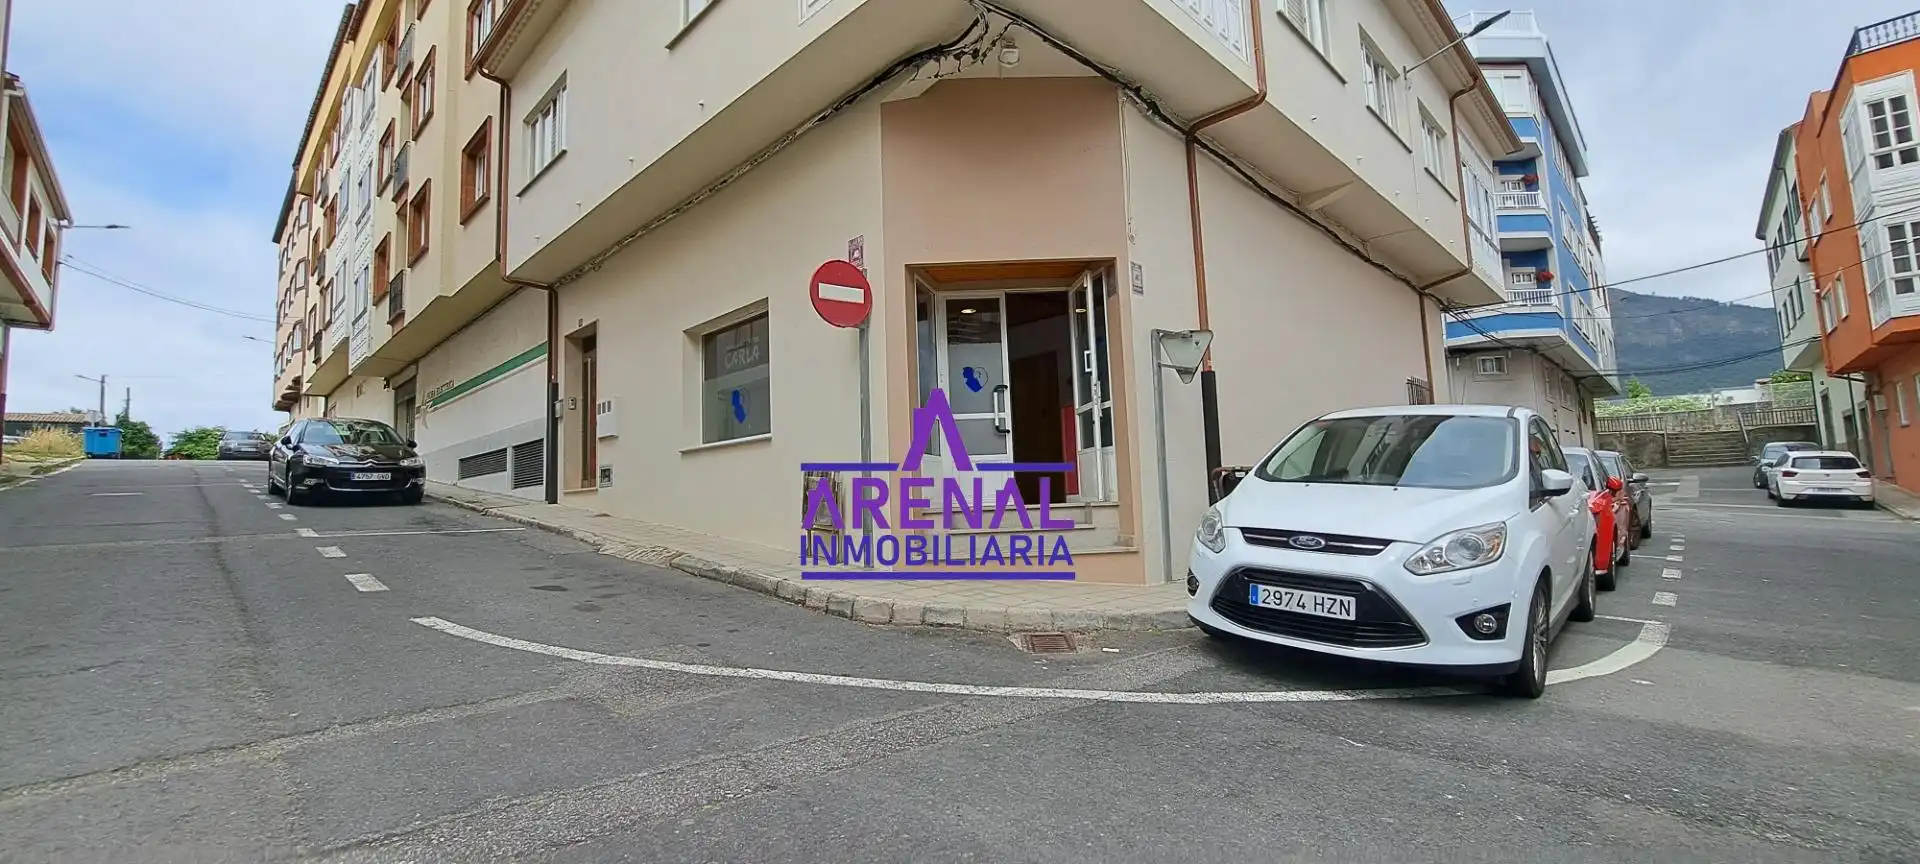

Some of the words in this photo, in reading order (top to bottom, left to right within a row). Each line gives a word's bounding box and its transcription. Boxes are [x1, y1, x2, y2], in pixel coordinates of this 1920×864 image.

[724, 345, 760, 369] CARLA
[1262, 588, 1306, 610] 2974
[1314, 595, 1351, 617] HZN
